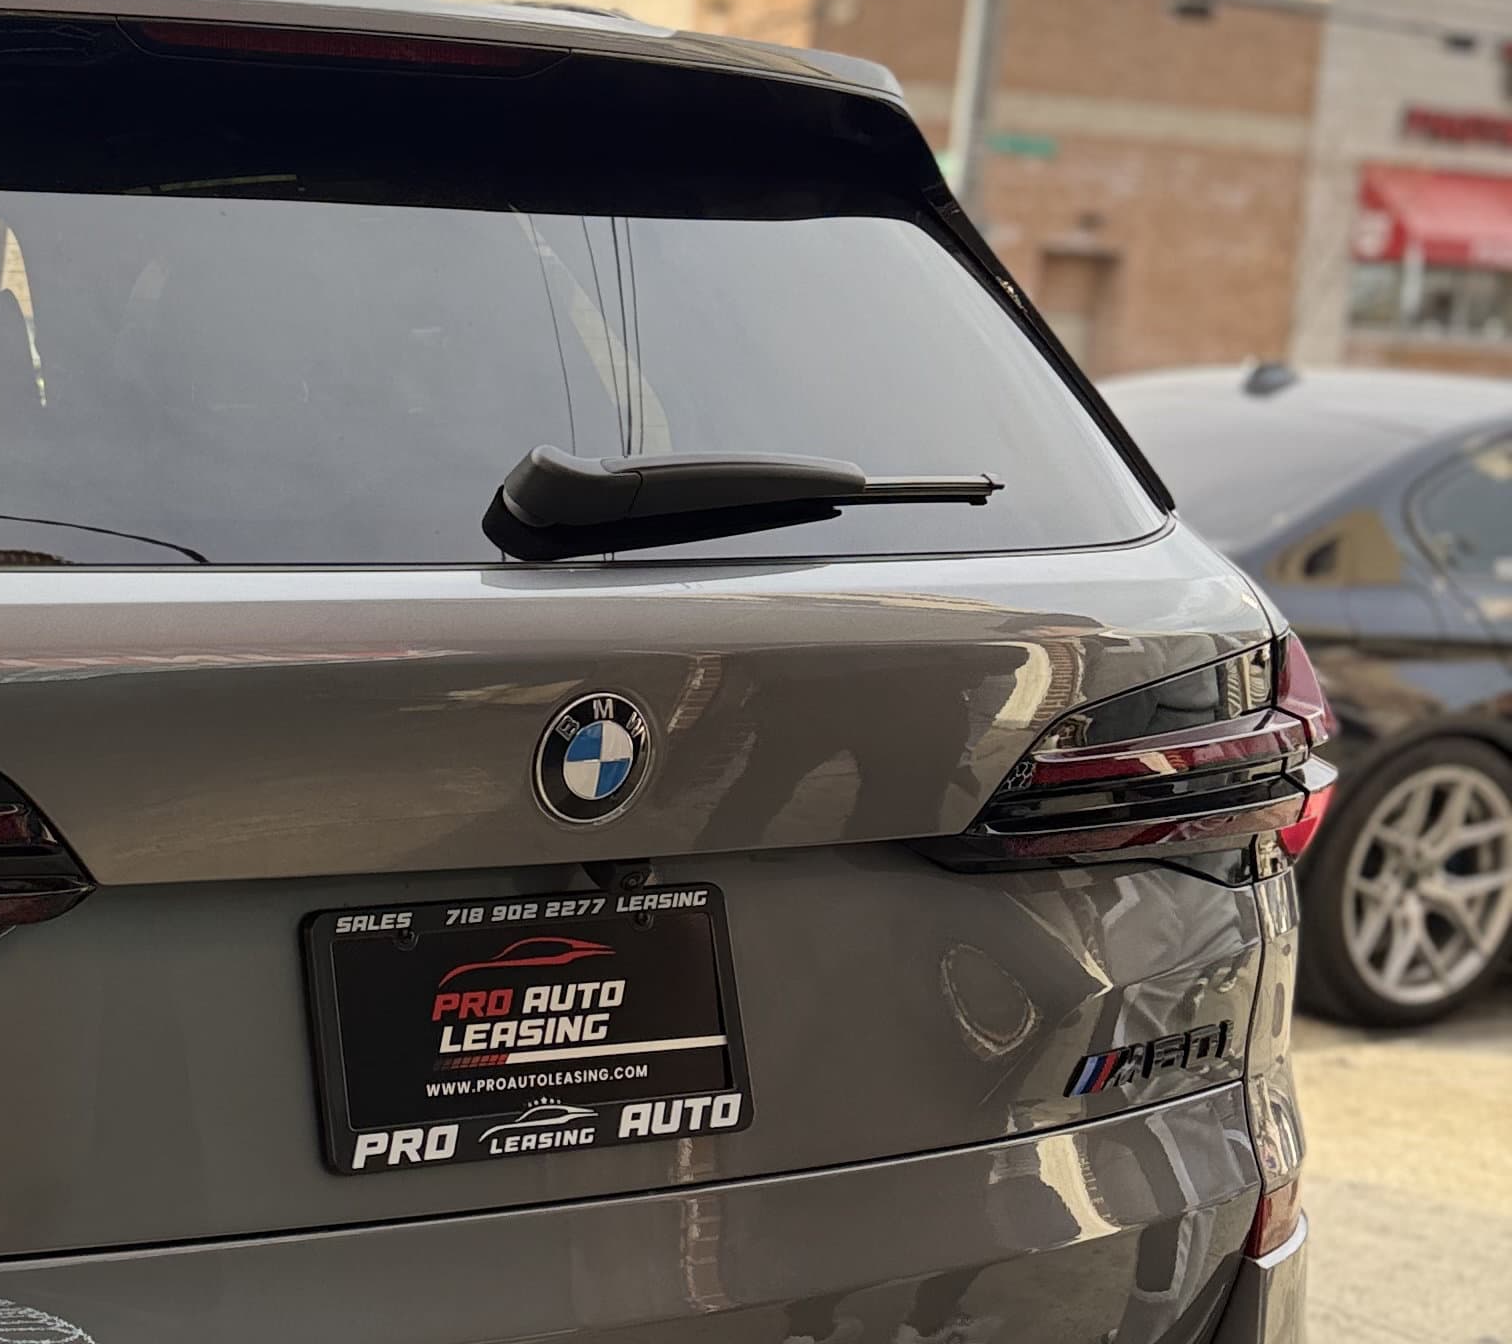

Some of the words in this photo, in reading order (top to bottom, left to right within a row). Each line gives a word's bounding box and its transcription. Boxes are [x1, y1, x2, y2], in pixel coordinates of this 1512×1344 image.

[555, 698, 647, 750] BMW
[336, 912, 413, 934] SALES
[445, 908, 485, 926] 718
[490, 903, 538, 923] 902
[544, 898, 606, 917] 2277
[616, 890, 708, 914] LEASING
[431, 988, 514, 1022] PRO
[522, 979, 626, 1014] AUTO
[439, 1013, 610, 1054] LEASING
[426, 1064, 649, 1098] WWW.PROAUTOLEASING.COM
[352, 1124, 460, 1170] PRO
[618, 1092, 743, 1139] AUTO
[489, 1128, 596, 1156] LEASING
